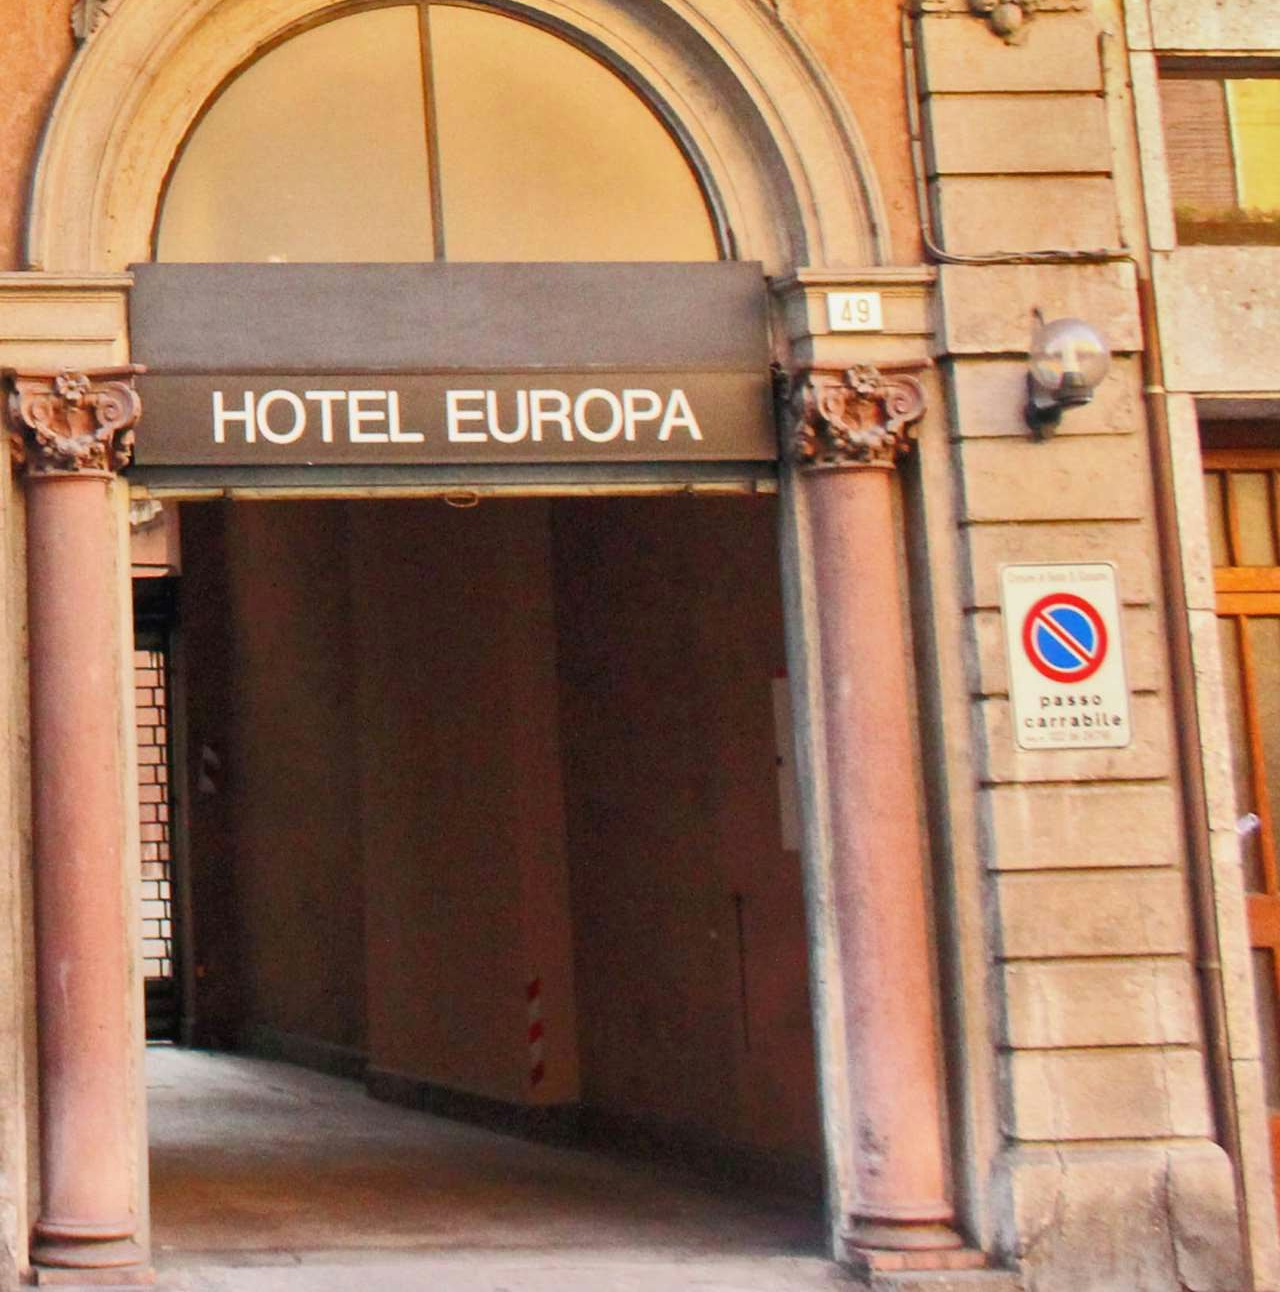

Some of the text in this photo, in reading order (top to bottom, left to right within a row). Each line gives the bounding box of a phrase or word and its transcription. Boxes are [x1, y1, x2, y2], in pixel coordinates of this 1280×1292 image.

[840, 298, 871, 324] 49
[212, 387, 703, 445] HOTEL EUROPA
[1040, 693, 1103, 709] passo
[1024, 713, 1123, 729] carrabile
